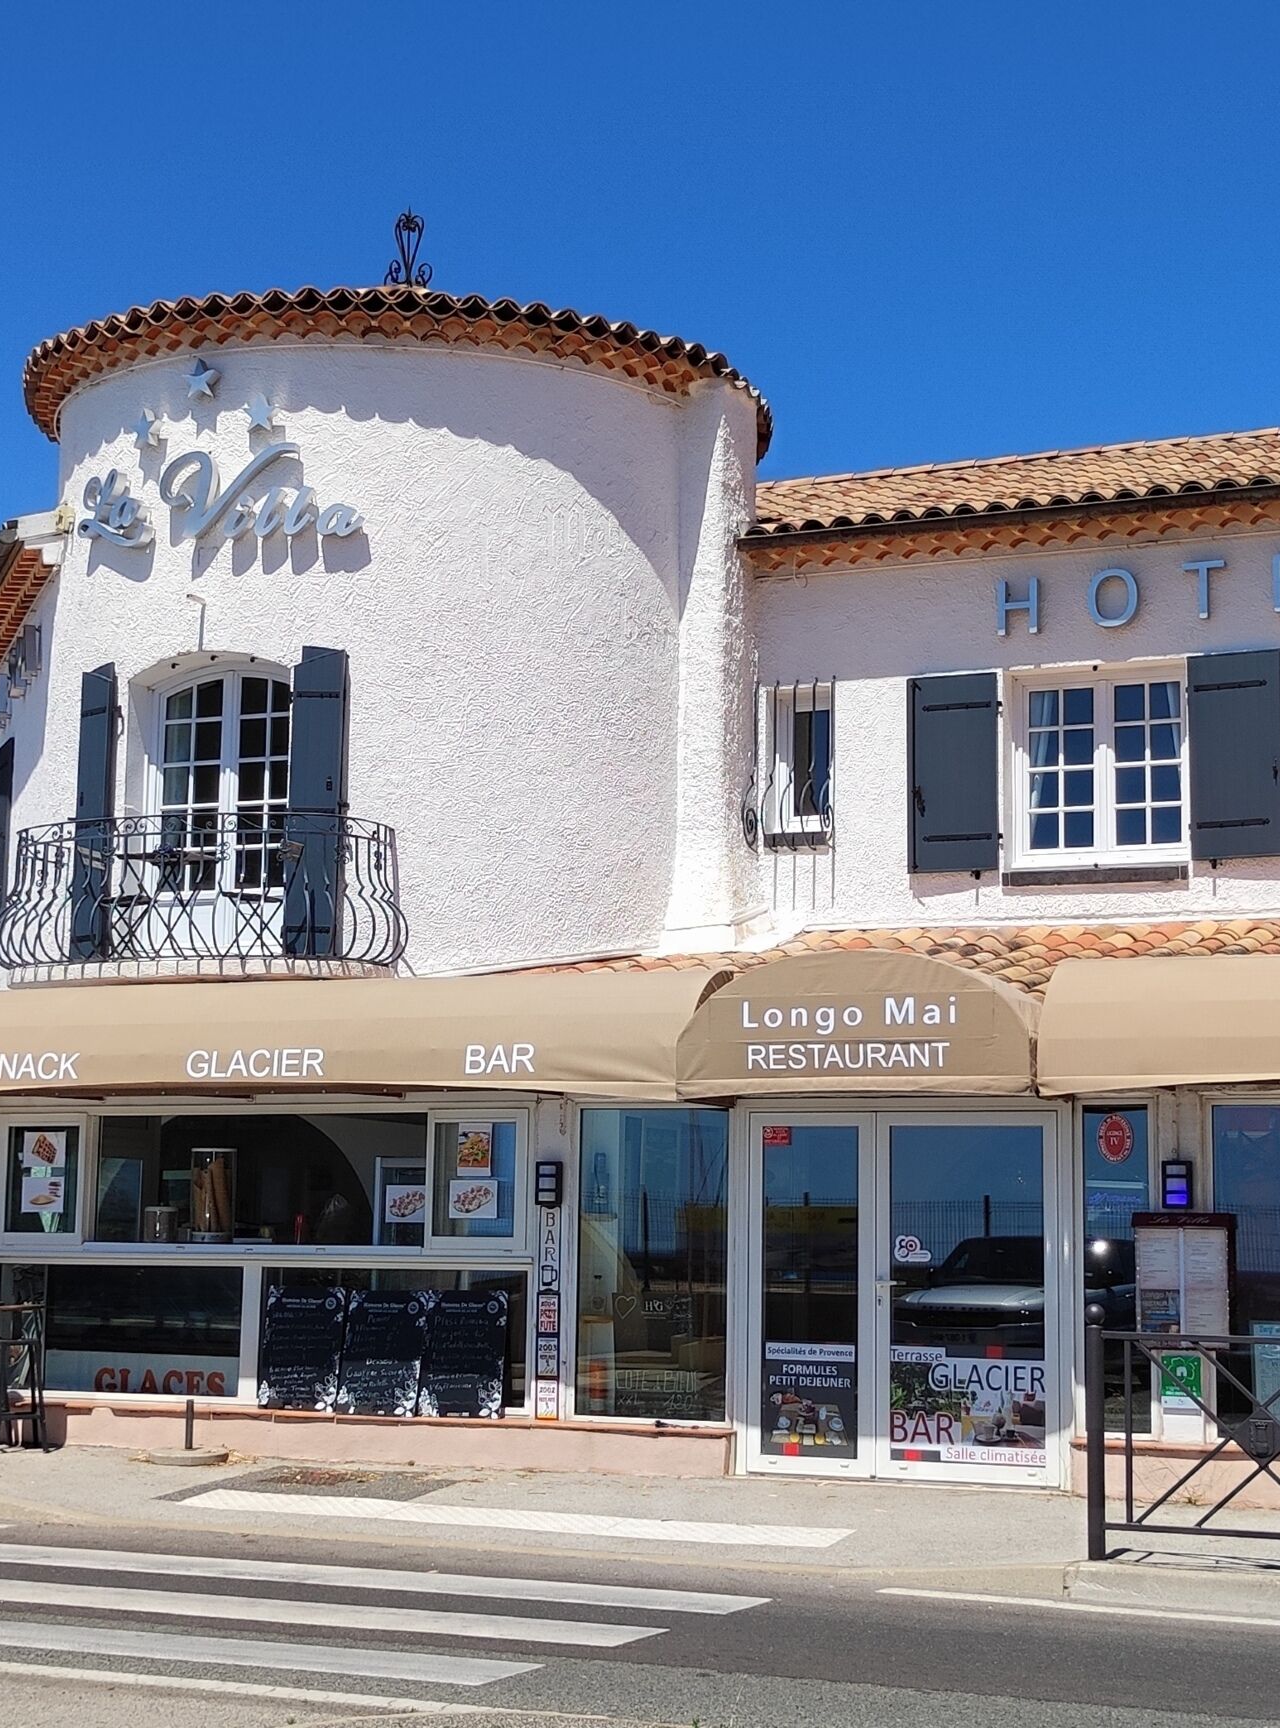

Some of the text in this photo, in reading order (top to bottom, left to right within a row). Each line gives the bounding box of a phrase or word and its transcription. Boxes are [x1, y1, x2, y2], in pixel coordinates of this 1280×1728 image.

[78, 442, 365, 547] La Villa
[742, 996, 957, 1036] Longo Mai
[186, 1048, 325, 1079] GLACIER
[464, 1043, 536, 1074] BAR
[746, 1041, 951, 1071] RESTAURANT
[544, 1212, 557, 1262] BAR
[539, 1343, 557, 1352] 2003
[767, 1346, 854, 1357] Spécialités de Provence
[891, 1349, 943, 1362] Terrasse
[769, 1375, 852, 1389] PETIT DEJEUNER
[782, 1364, 838, 1376] FORMULES
[930, 1363, 1046, 1394] GLACIER
[891, 1411, 955, 1446] BAR
[946, 1447, 1047, 1465] Salle climatisée
